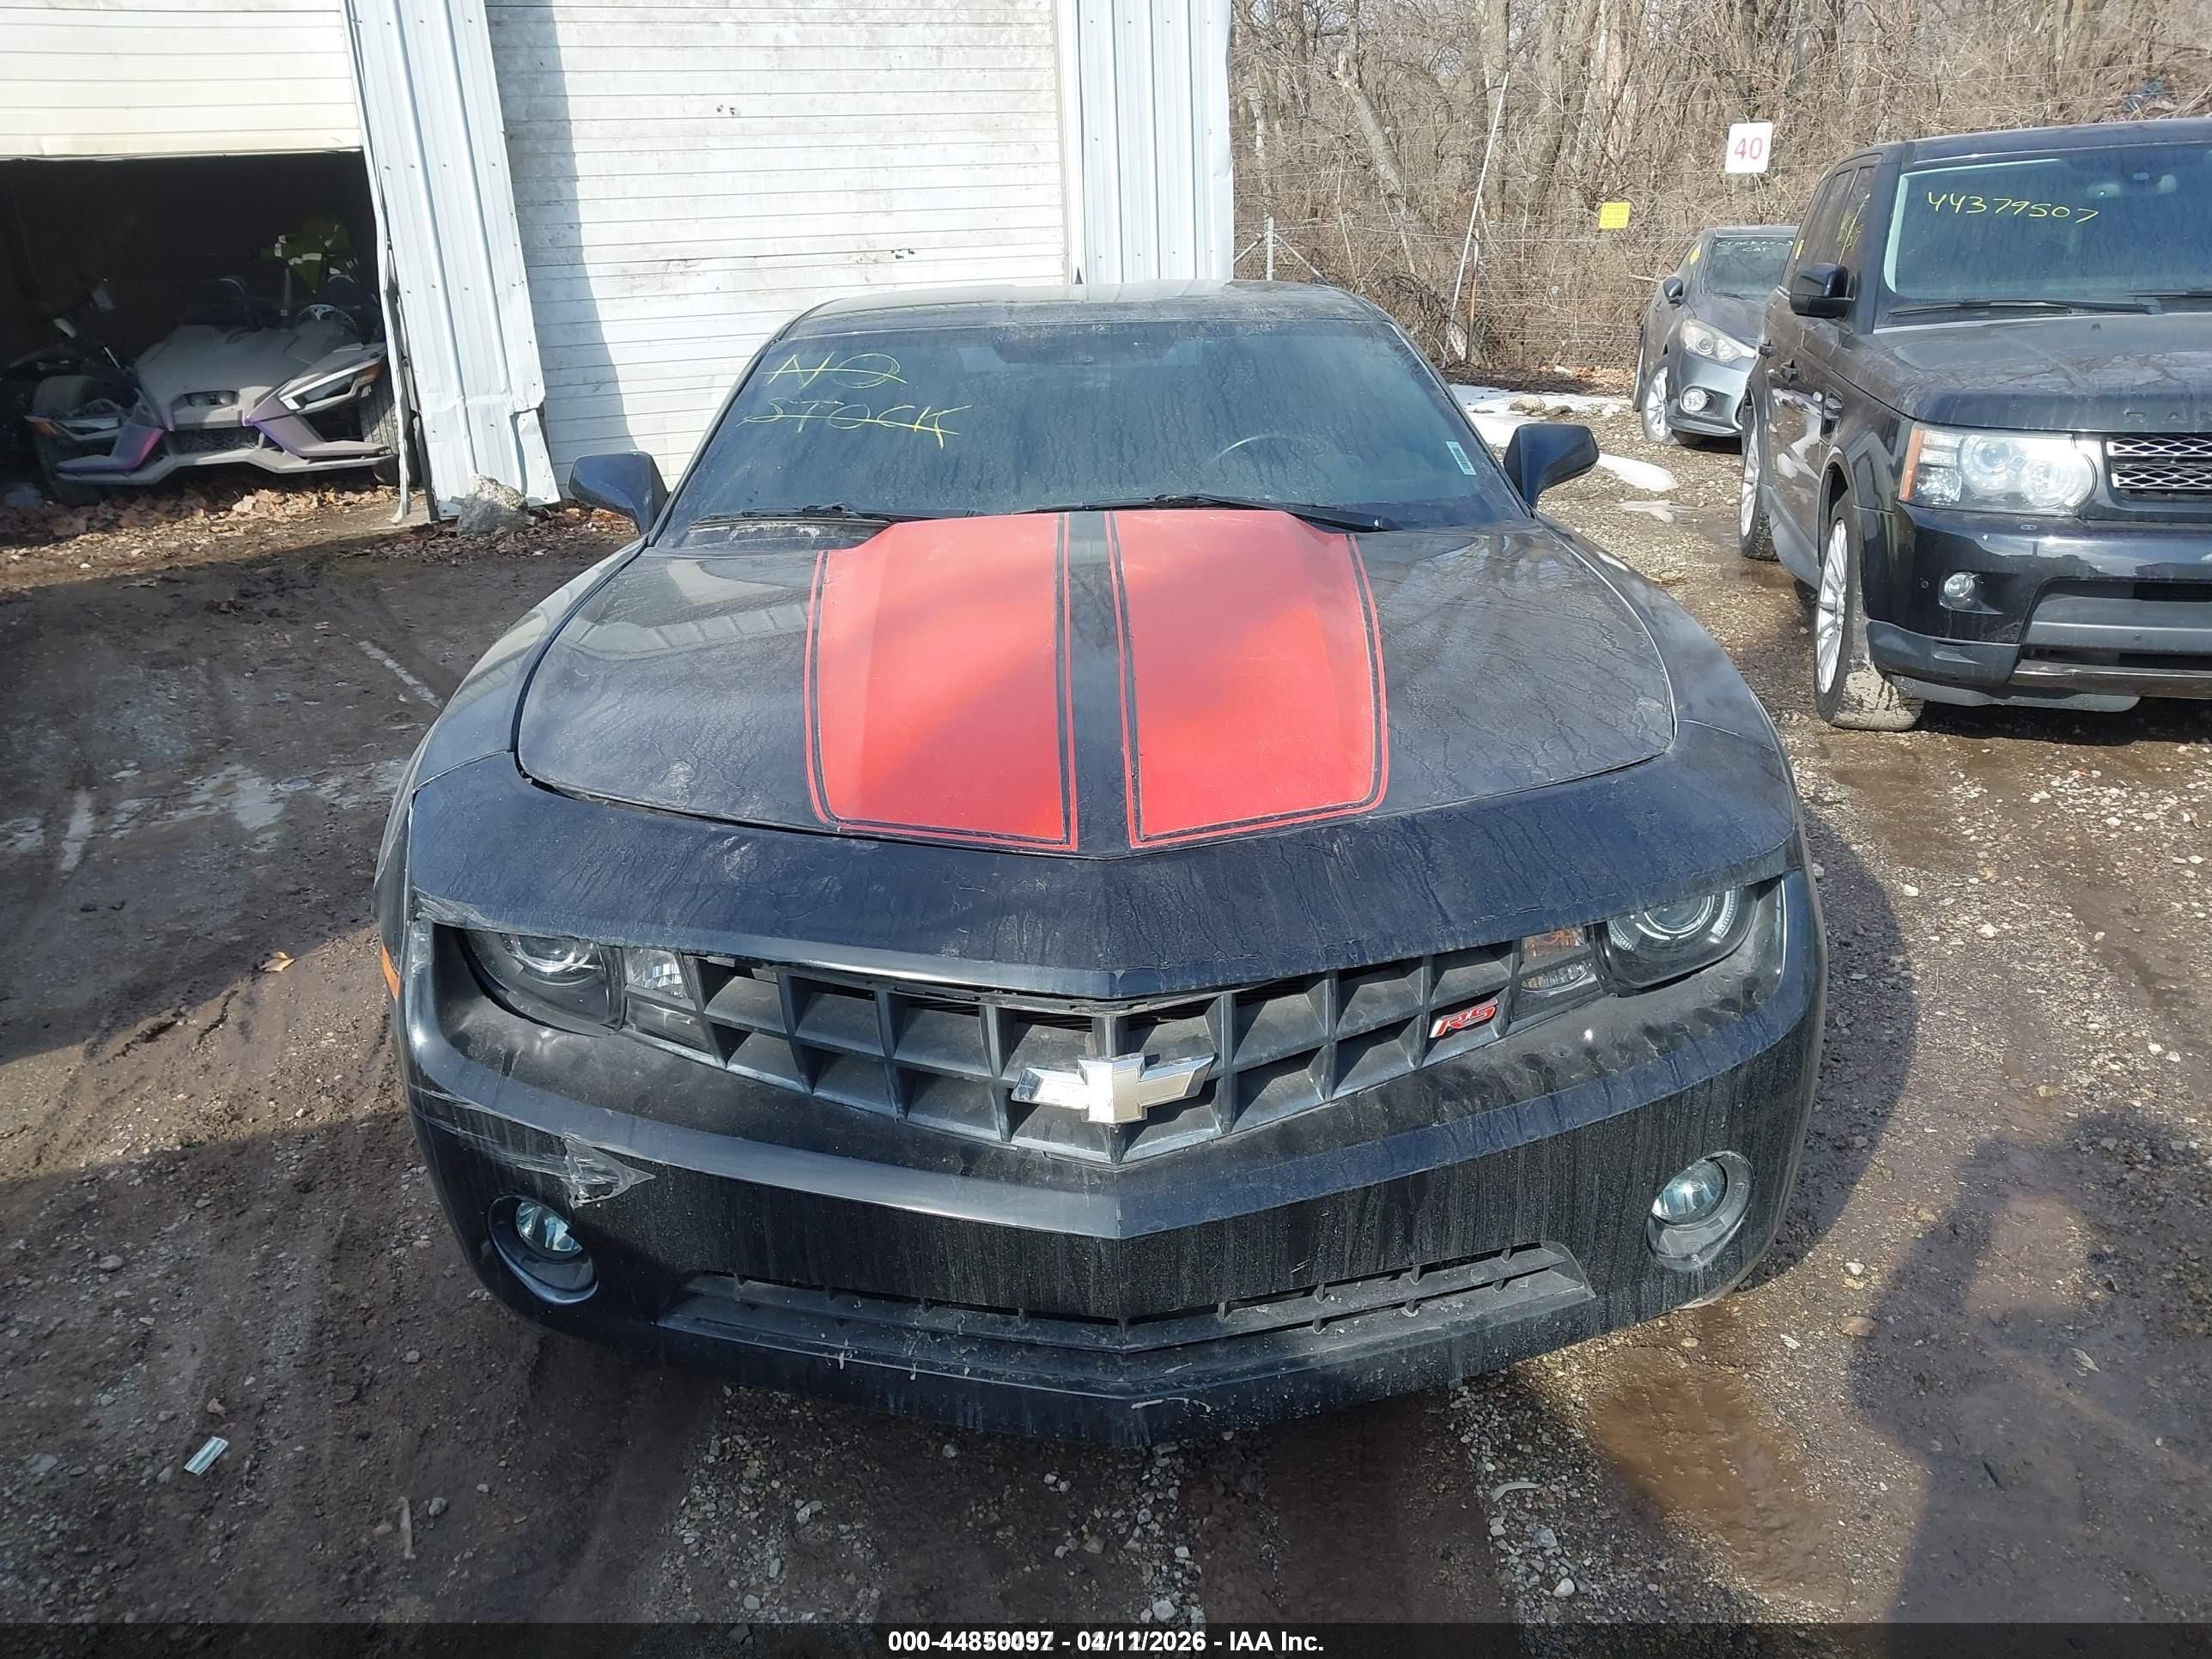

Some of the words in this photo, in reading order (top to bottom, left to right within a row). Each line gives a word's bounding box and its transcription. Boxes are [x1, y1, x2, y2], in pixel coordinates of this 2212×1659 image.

[1735, 137, 1763, 160] 40
[1928, 191, 2100, 223] 44379507
[763, 350, 907, 389] NO
[735, 397, 973, 450] STOCK
[1429, 997, 1498, 1038] RS
